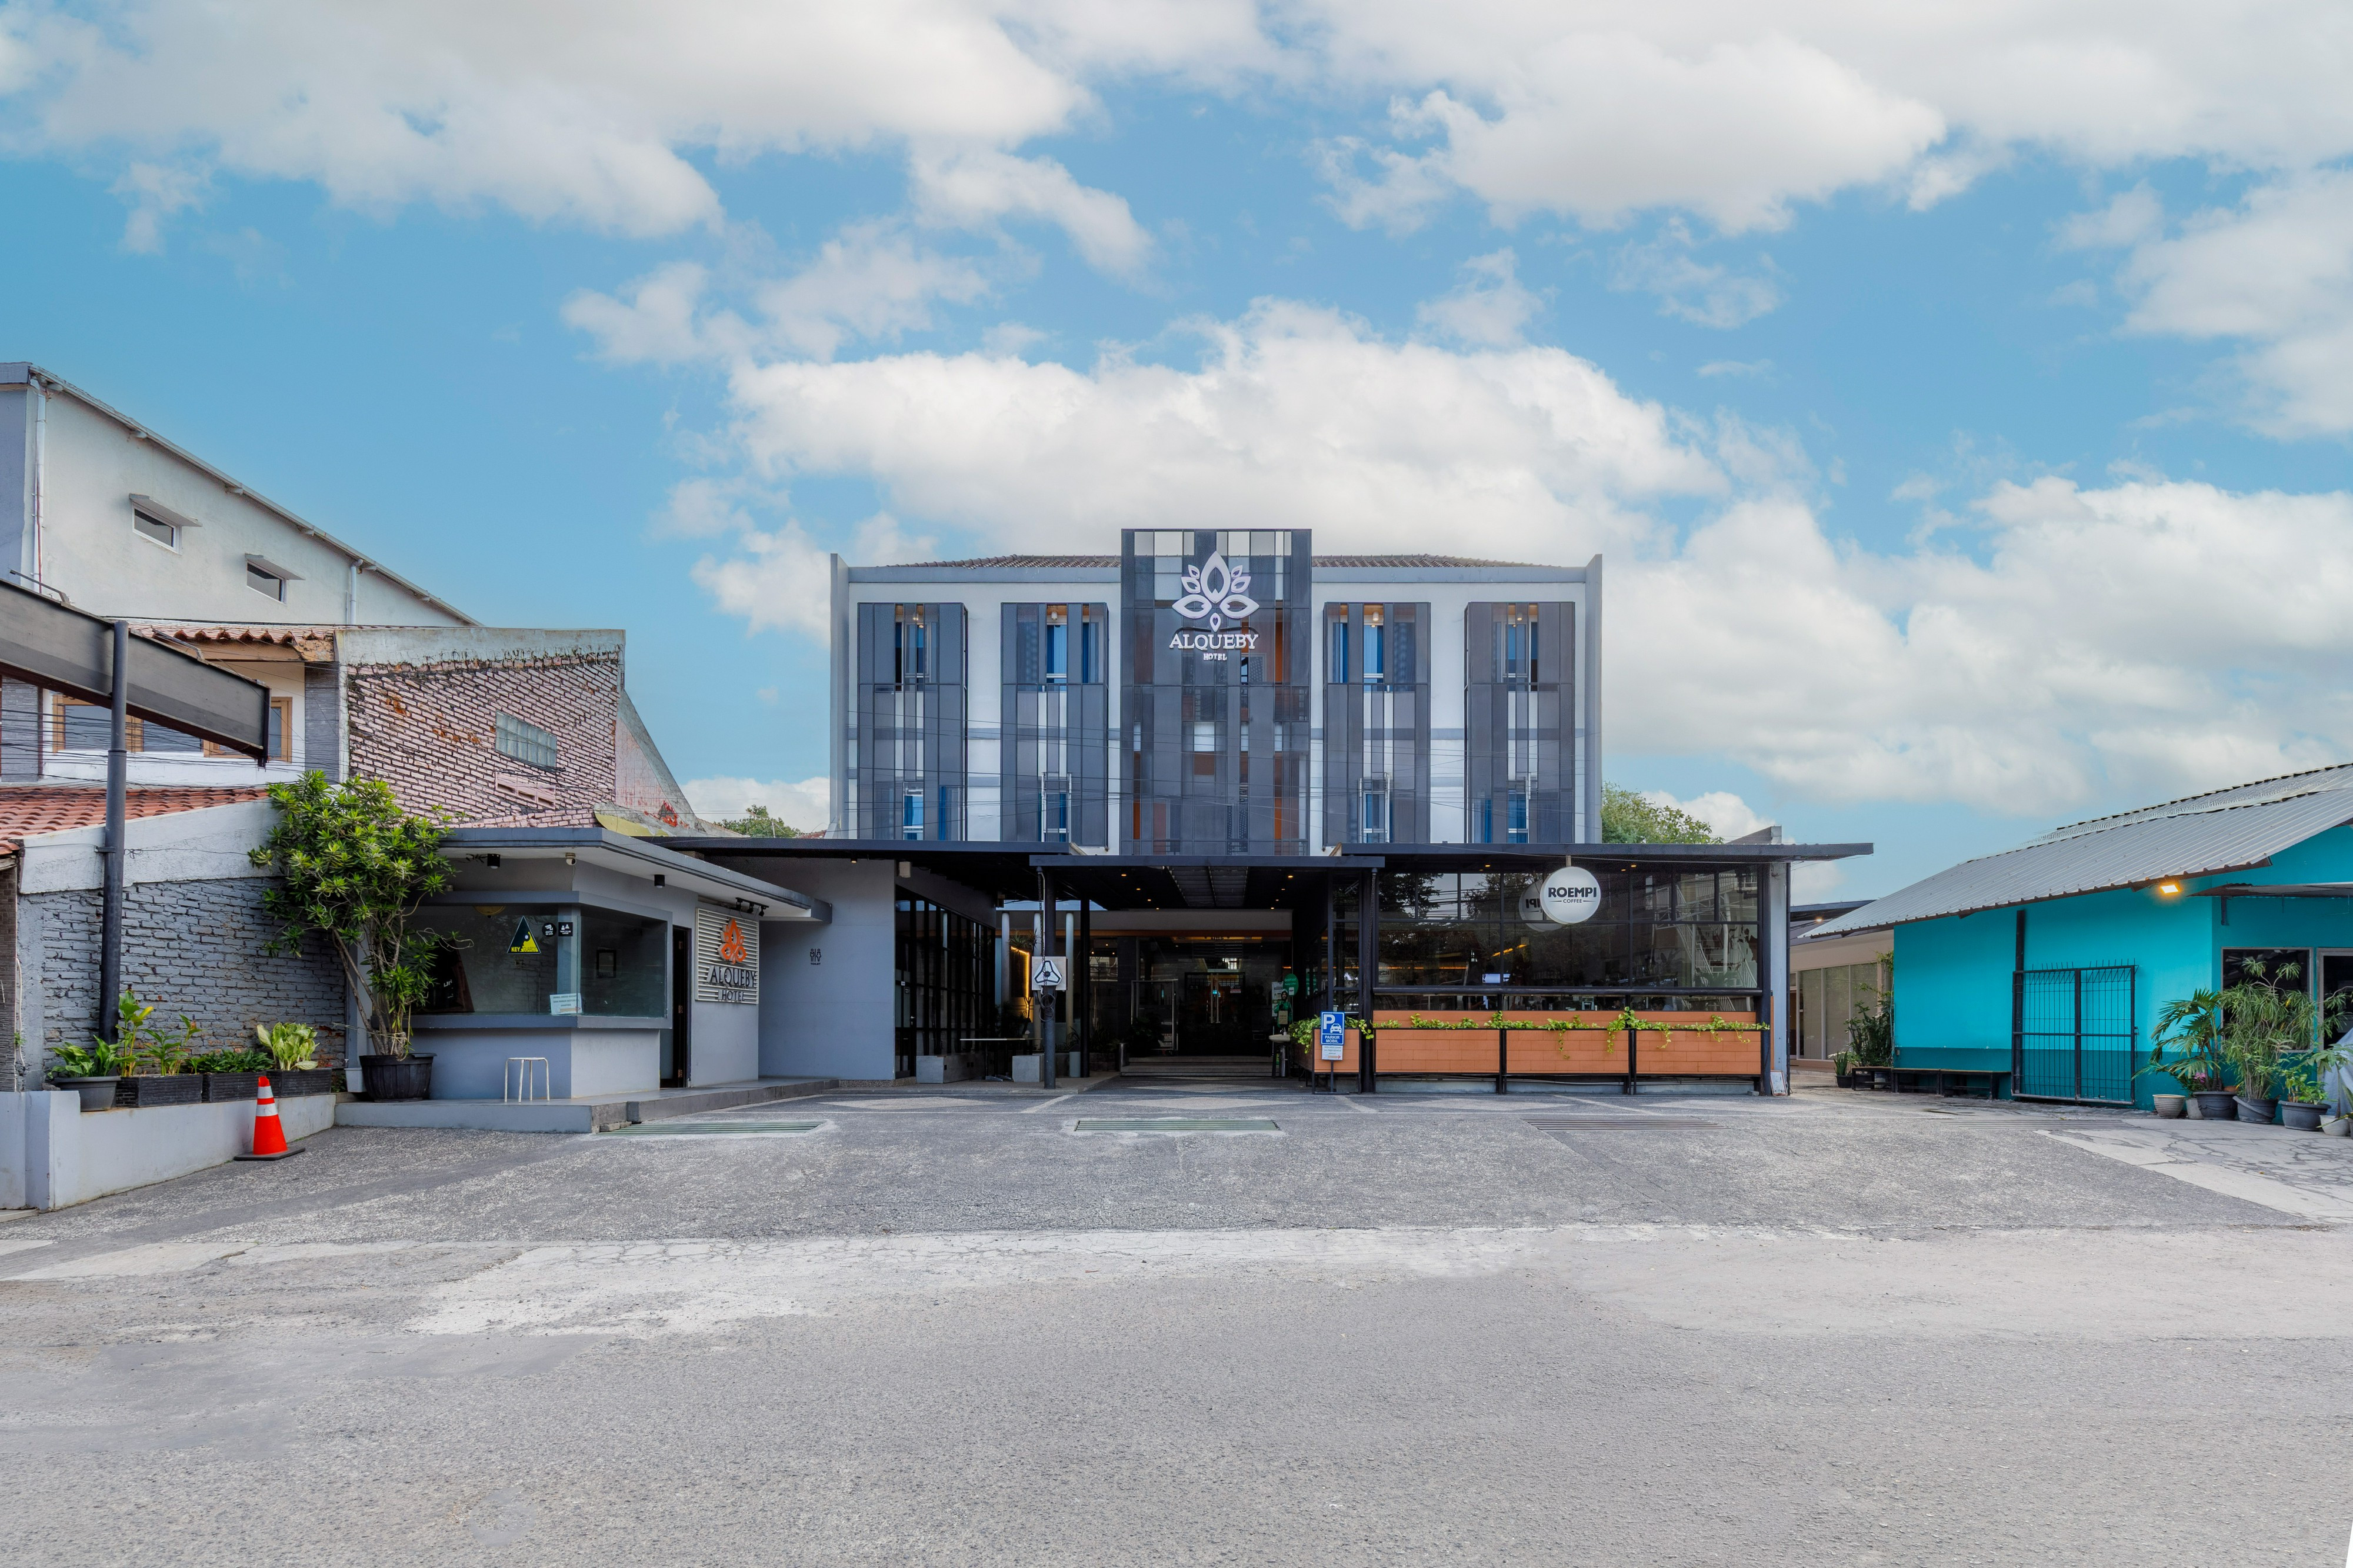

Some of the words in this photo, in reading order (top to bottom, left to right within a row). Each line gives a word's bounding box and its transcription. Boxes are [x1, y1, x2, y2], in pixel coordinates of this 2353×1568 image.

[1169, 634, 1259, 650] ALQUEBY
[1203, 653, 1227, 661] HOTEL
[1548, 887, 1597, 898] ROEMPI
[709, 966, 756, 987] ALQUEBY
[722, 989, 745, 1002] HOTEL
[1323, 1014, 1335, 1030] P
